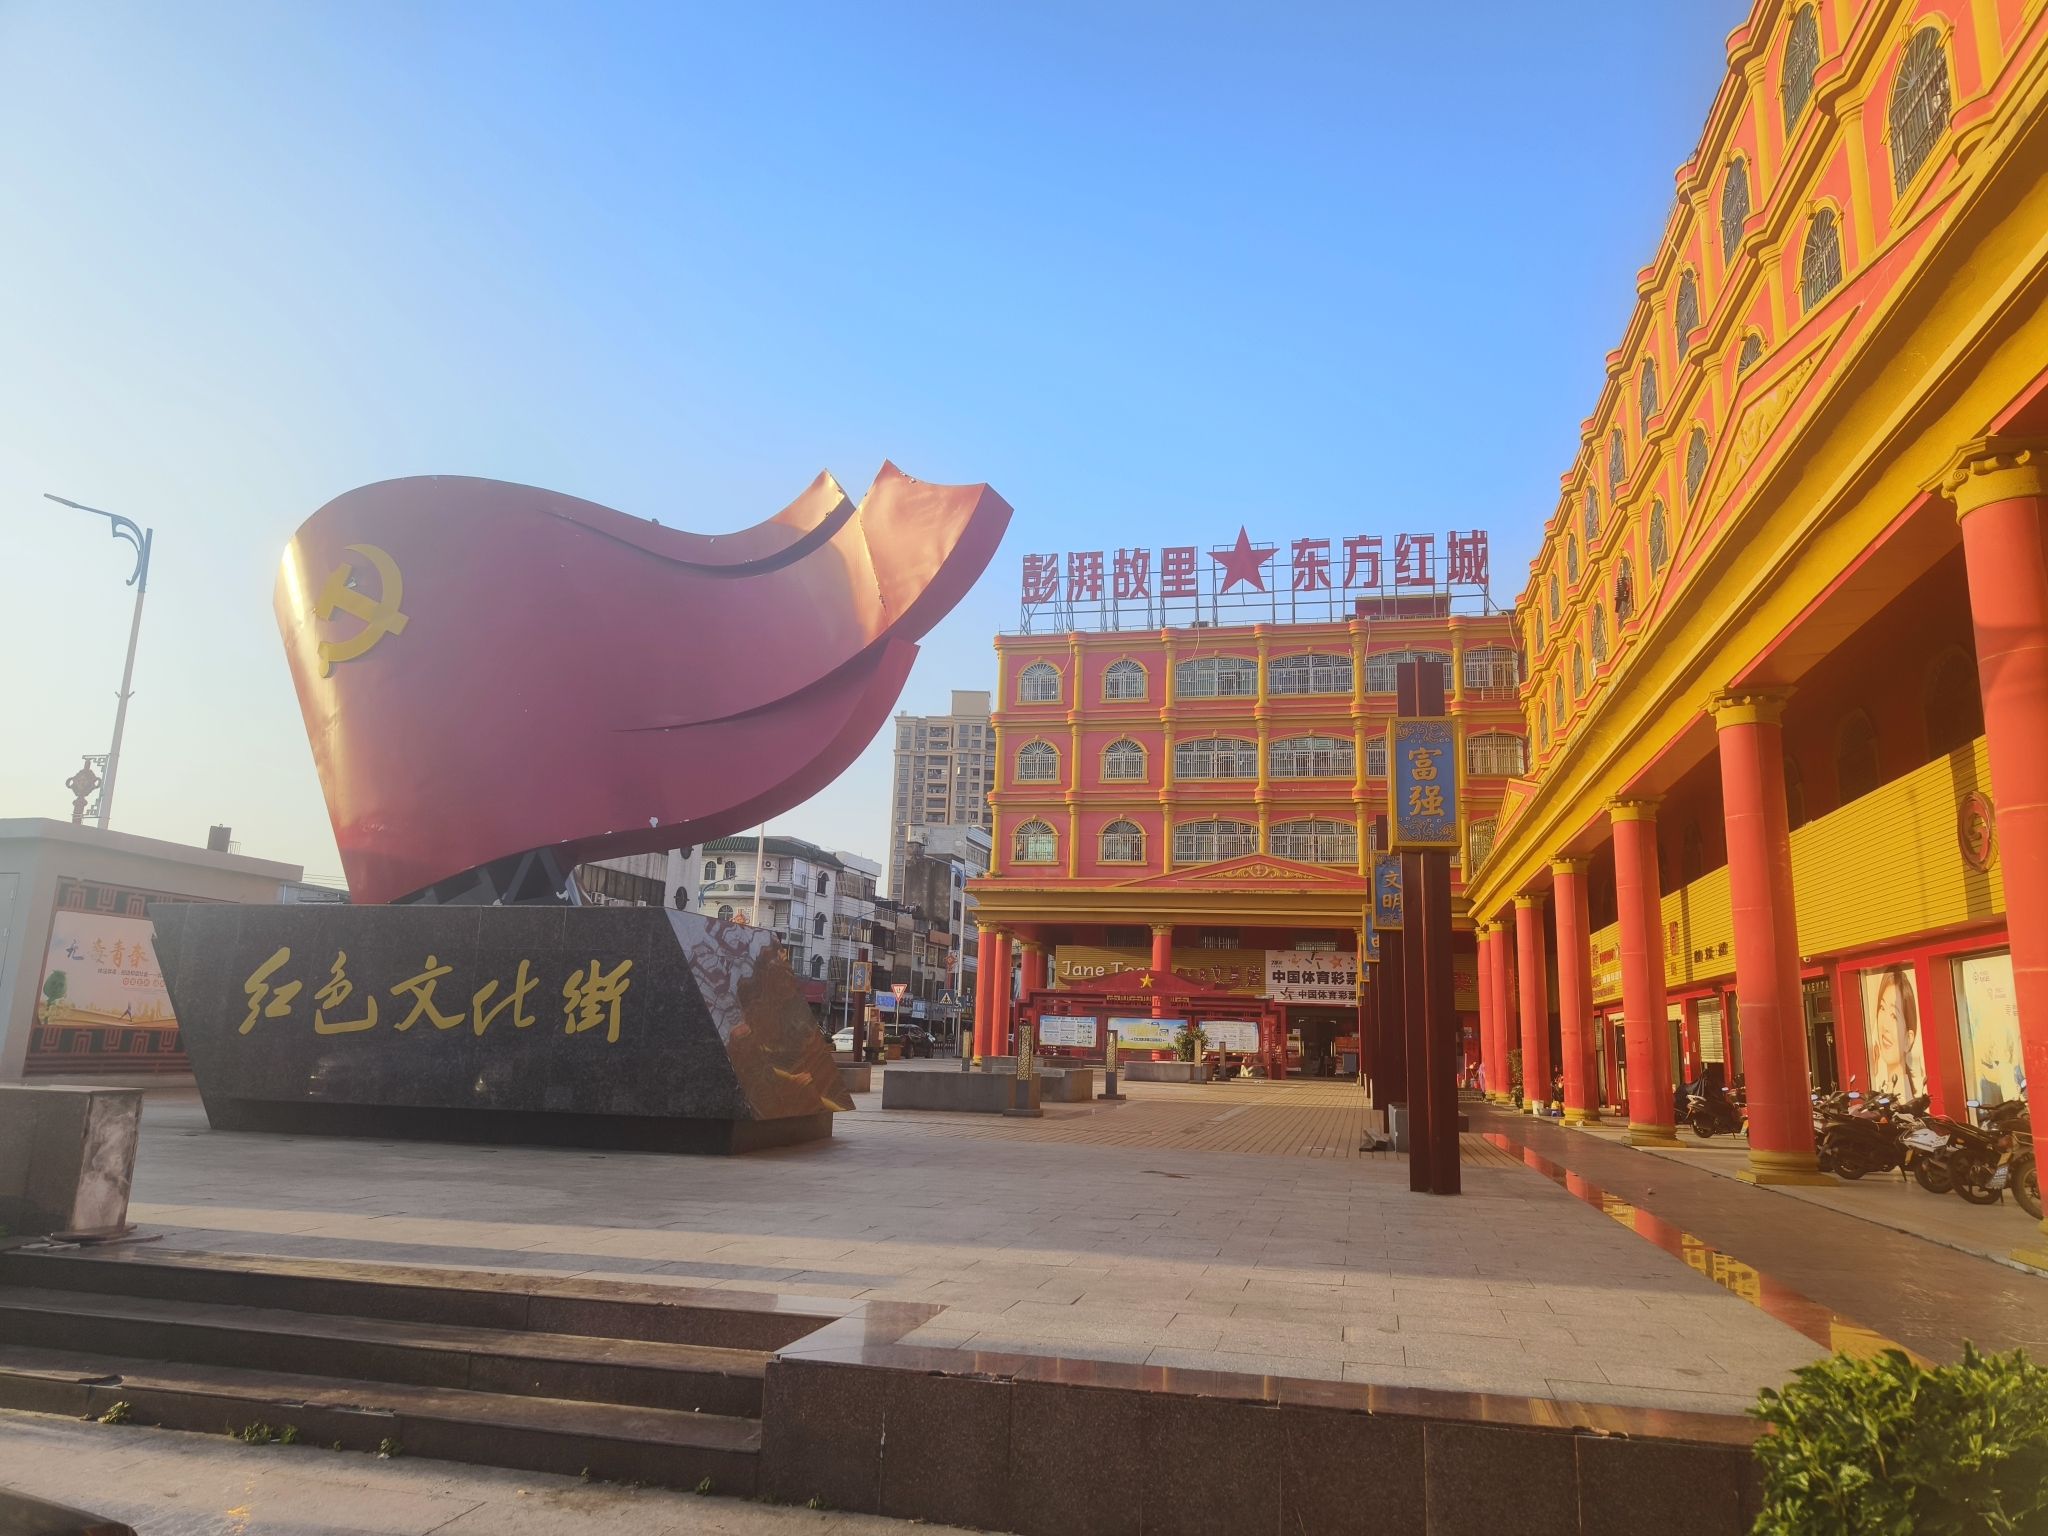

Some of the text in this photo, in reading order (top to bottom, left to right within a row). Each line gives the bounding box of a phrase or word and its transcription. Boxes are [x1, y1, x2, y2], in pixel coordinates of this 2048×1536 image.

[1022, 530, 1489, 604] 彭湃故里 东方红城
[1408, 747, 1445, 817] 富强
[1383, 870, 1402, 912] 文明
[238, 946, 633, 1043] 红色文化街
[1061, 960, 1105, 977] Jane
[1272, 969, 1357, 985] 中国体育彩票
